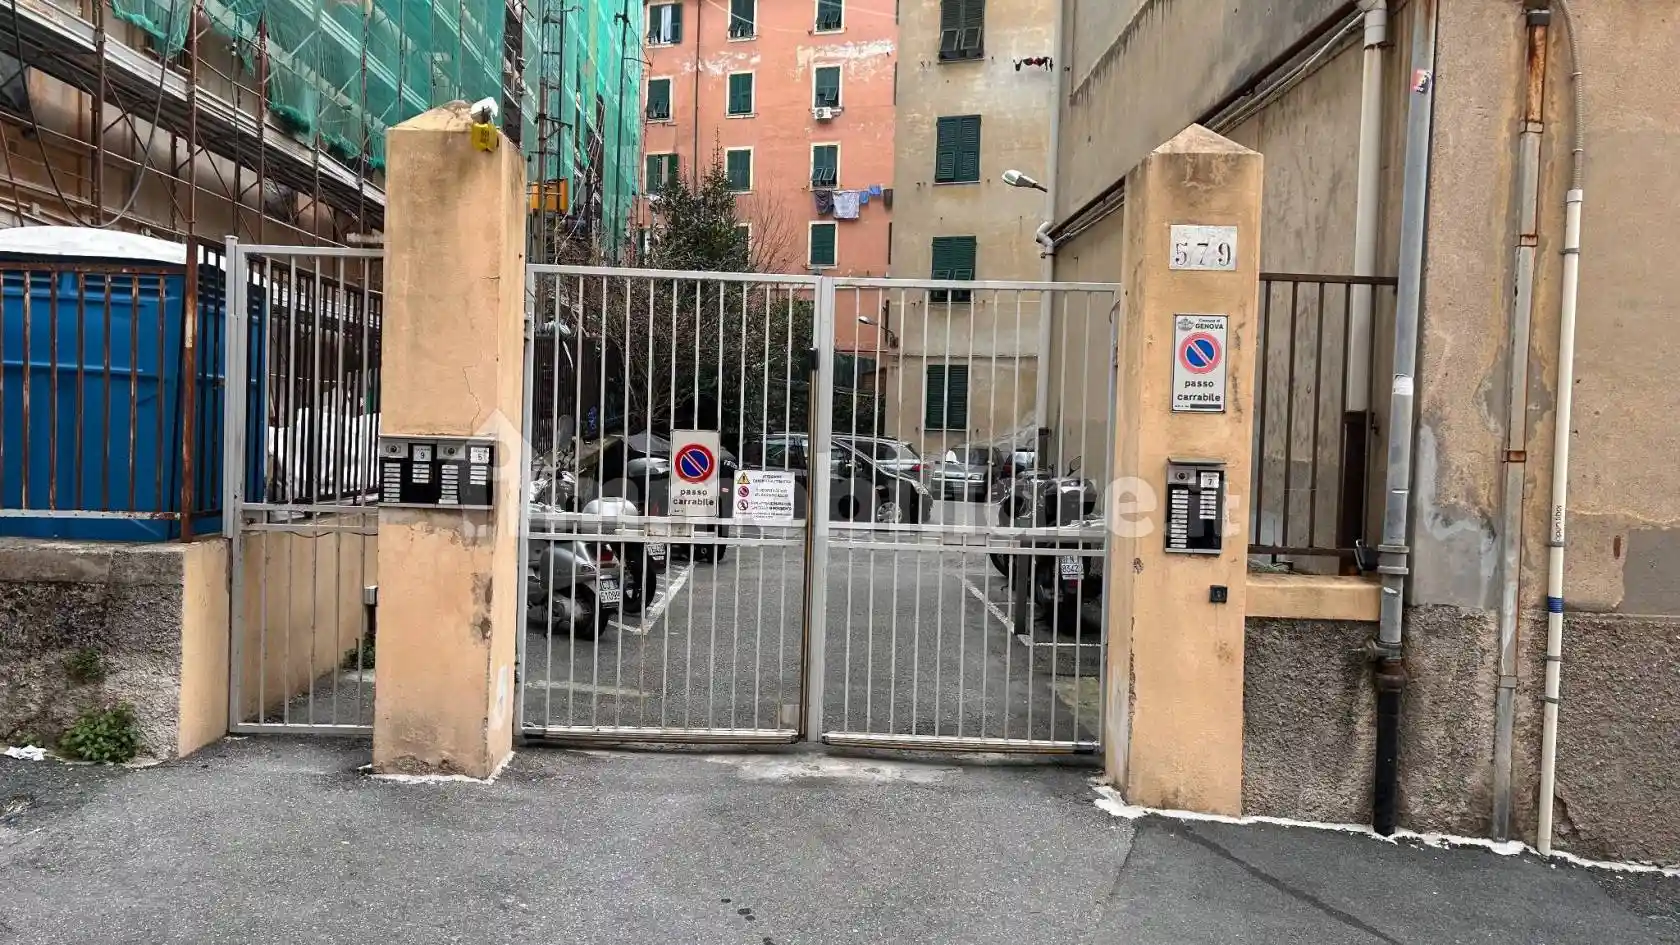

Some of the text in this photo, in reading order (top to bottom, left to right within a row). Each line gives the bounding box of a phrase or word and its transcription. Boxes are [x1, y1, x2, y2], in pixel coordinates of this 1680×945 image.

[1175, 242, 1232, 267] 579
[1184, 380, 1214, 389] passo
[1177, 392, 1221, 402] carrabile
[680, 489, 708, 497] passo
[673, 498, 715, 506] carrabile
